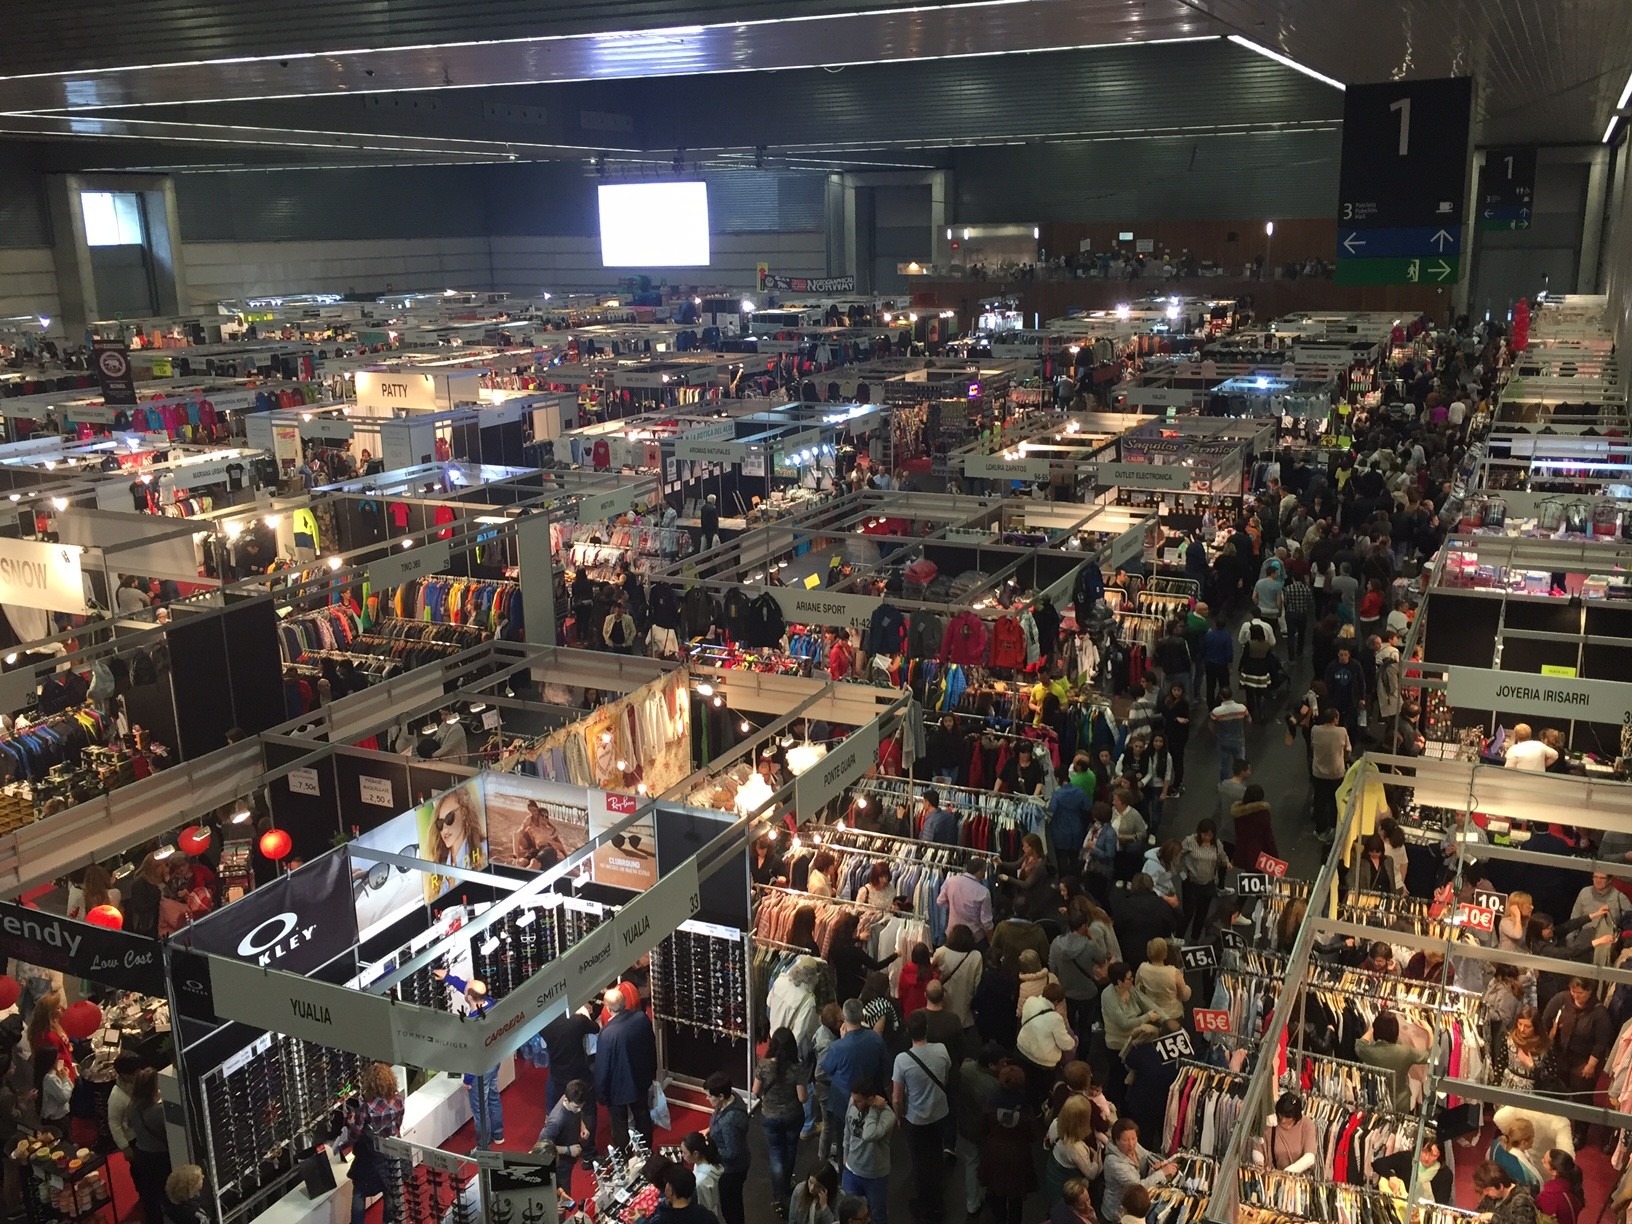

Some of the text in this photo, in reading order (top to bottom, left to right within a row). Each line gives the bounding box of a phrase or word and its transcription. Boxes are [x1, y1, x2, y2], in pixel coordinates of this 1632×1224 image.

[1389, 98, 1411, 155] 1
[1504, 156, 1513, 179] 1
[1343, 203, 1352, 219] 3
[382, 384, 408, 398] PATTY
[1124, 440, 1178, 454] Saquitos
[986, 463, 1027, 473] LOKURA ZAPATOS
[1115, 471, 1172, 481] OUTLET ELECTRONICA
[1, 557, 48, 590] SNOW
[796, 601, 846, 616] ARIANE SPORT
[850, 617, 871, 629] 41-42
[26, 692, 37, 705] 29
[1496, 685, 1590, 706] JOYERIA IRISARRI
[1624, 711, 1632, 725] 3
[824, 753, 856, 787] PONTE GUAPA
[608, 796, 635, 811] Ray-Ban
[1260, 856, 1285, 876] 10€
[1241, 878, 1265, 892] 10€
[690, 893, 698, 913] 33
[1478, 894, 1504, 913] 10€
[1463, 908, 1491, 928] 10€
[623, 915, 651, 947] YUALIA
[0, 912, 153, 970] endy Low Cost
[583, 942, 611, 971] Polaroid
[1186, 951, 1213, 967] 15€
[536, 978, 567, 1008] SMITH
[290, 997, 333, 1025] YUALIA
[484, 1011, 525, 1047] CARRERA
[1195, 1012, 1228, 1030] 15€
[396, 1030, 469, 1049] TOMMY HILFIGER
[1155, 1035, 1190, 1061] 15€
